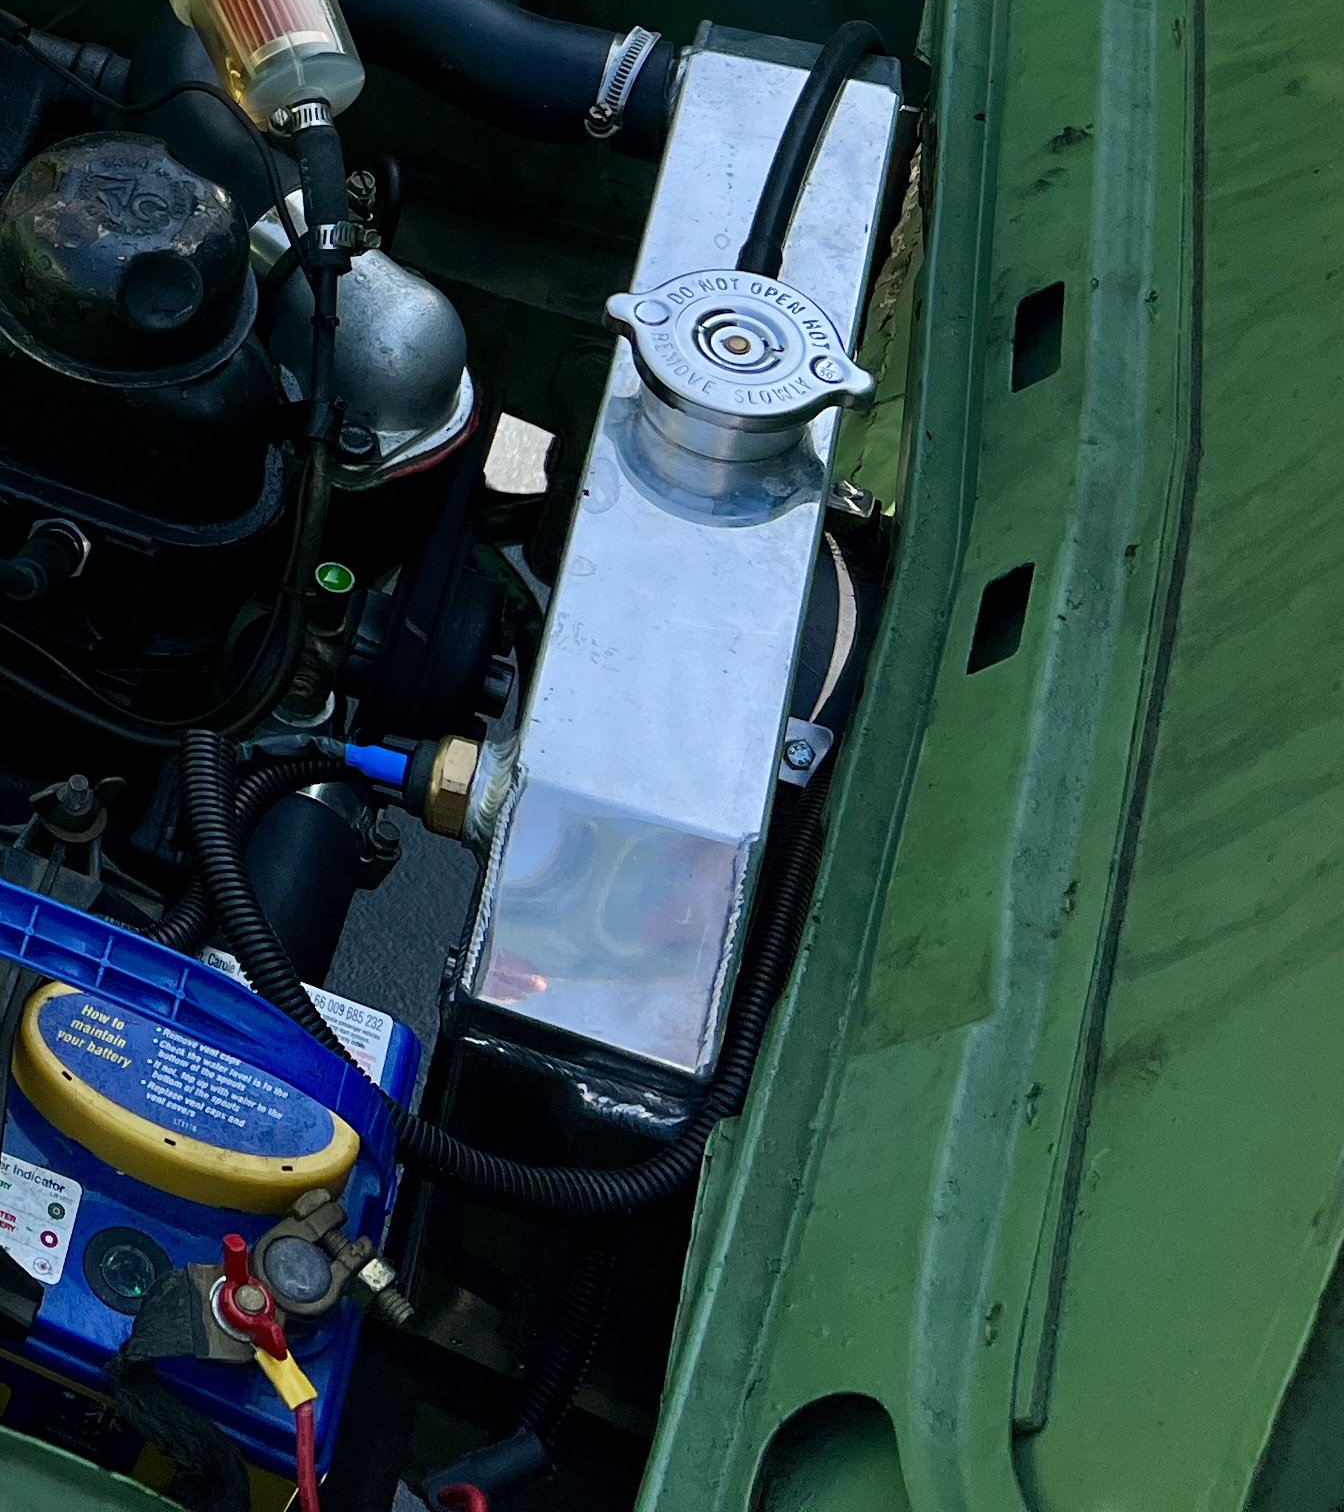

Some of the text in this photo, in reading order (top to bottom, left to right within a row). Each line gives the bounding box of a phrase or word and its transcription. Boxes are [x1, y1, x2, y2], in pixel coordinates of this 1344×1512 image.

[667, 277, 830, 351] DO NOT OPEN HOT
[651, 332, 812, 405] REMOVE SLOWLY
[207, 952, 237, 974] Carole
[70, 1018, 128, 1049] maintain
[81, 1003, 126, 1031] How to
[327, 999, 346, 1017] 009
[346, 1006, 365, 1025] 685
[365, 1013, 385, 1034] 232
[57, 1029, 132, 1069] your battery
[162, 1027, 242, 1067] Remove vent caps
[157, 1049, 247, 1092] bottom of the spouts
[159, 1039, 289, 1100] Check the water level is to the
[146, 1081, 247, 1128] Replace vent caps and
[146, 1092, 197, 1118] vent covers
[151, 1070, 241, 1113] bottom of the spouts
[180, 1071, 197, 1084] top
[196, 1079, 209, 1090] up
[210, 1084, 230, 1098] with
[230, 1093, 258, 1108] water
[257, 1103, 267, 1113] to
[267, 1107, 283, 1120] the
[12, 1163, 66, 1194] Indicator
